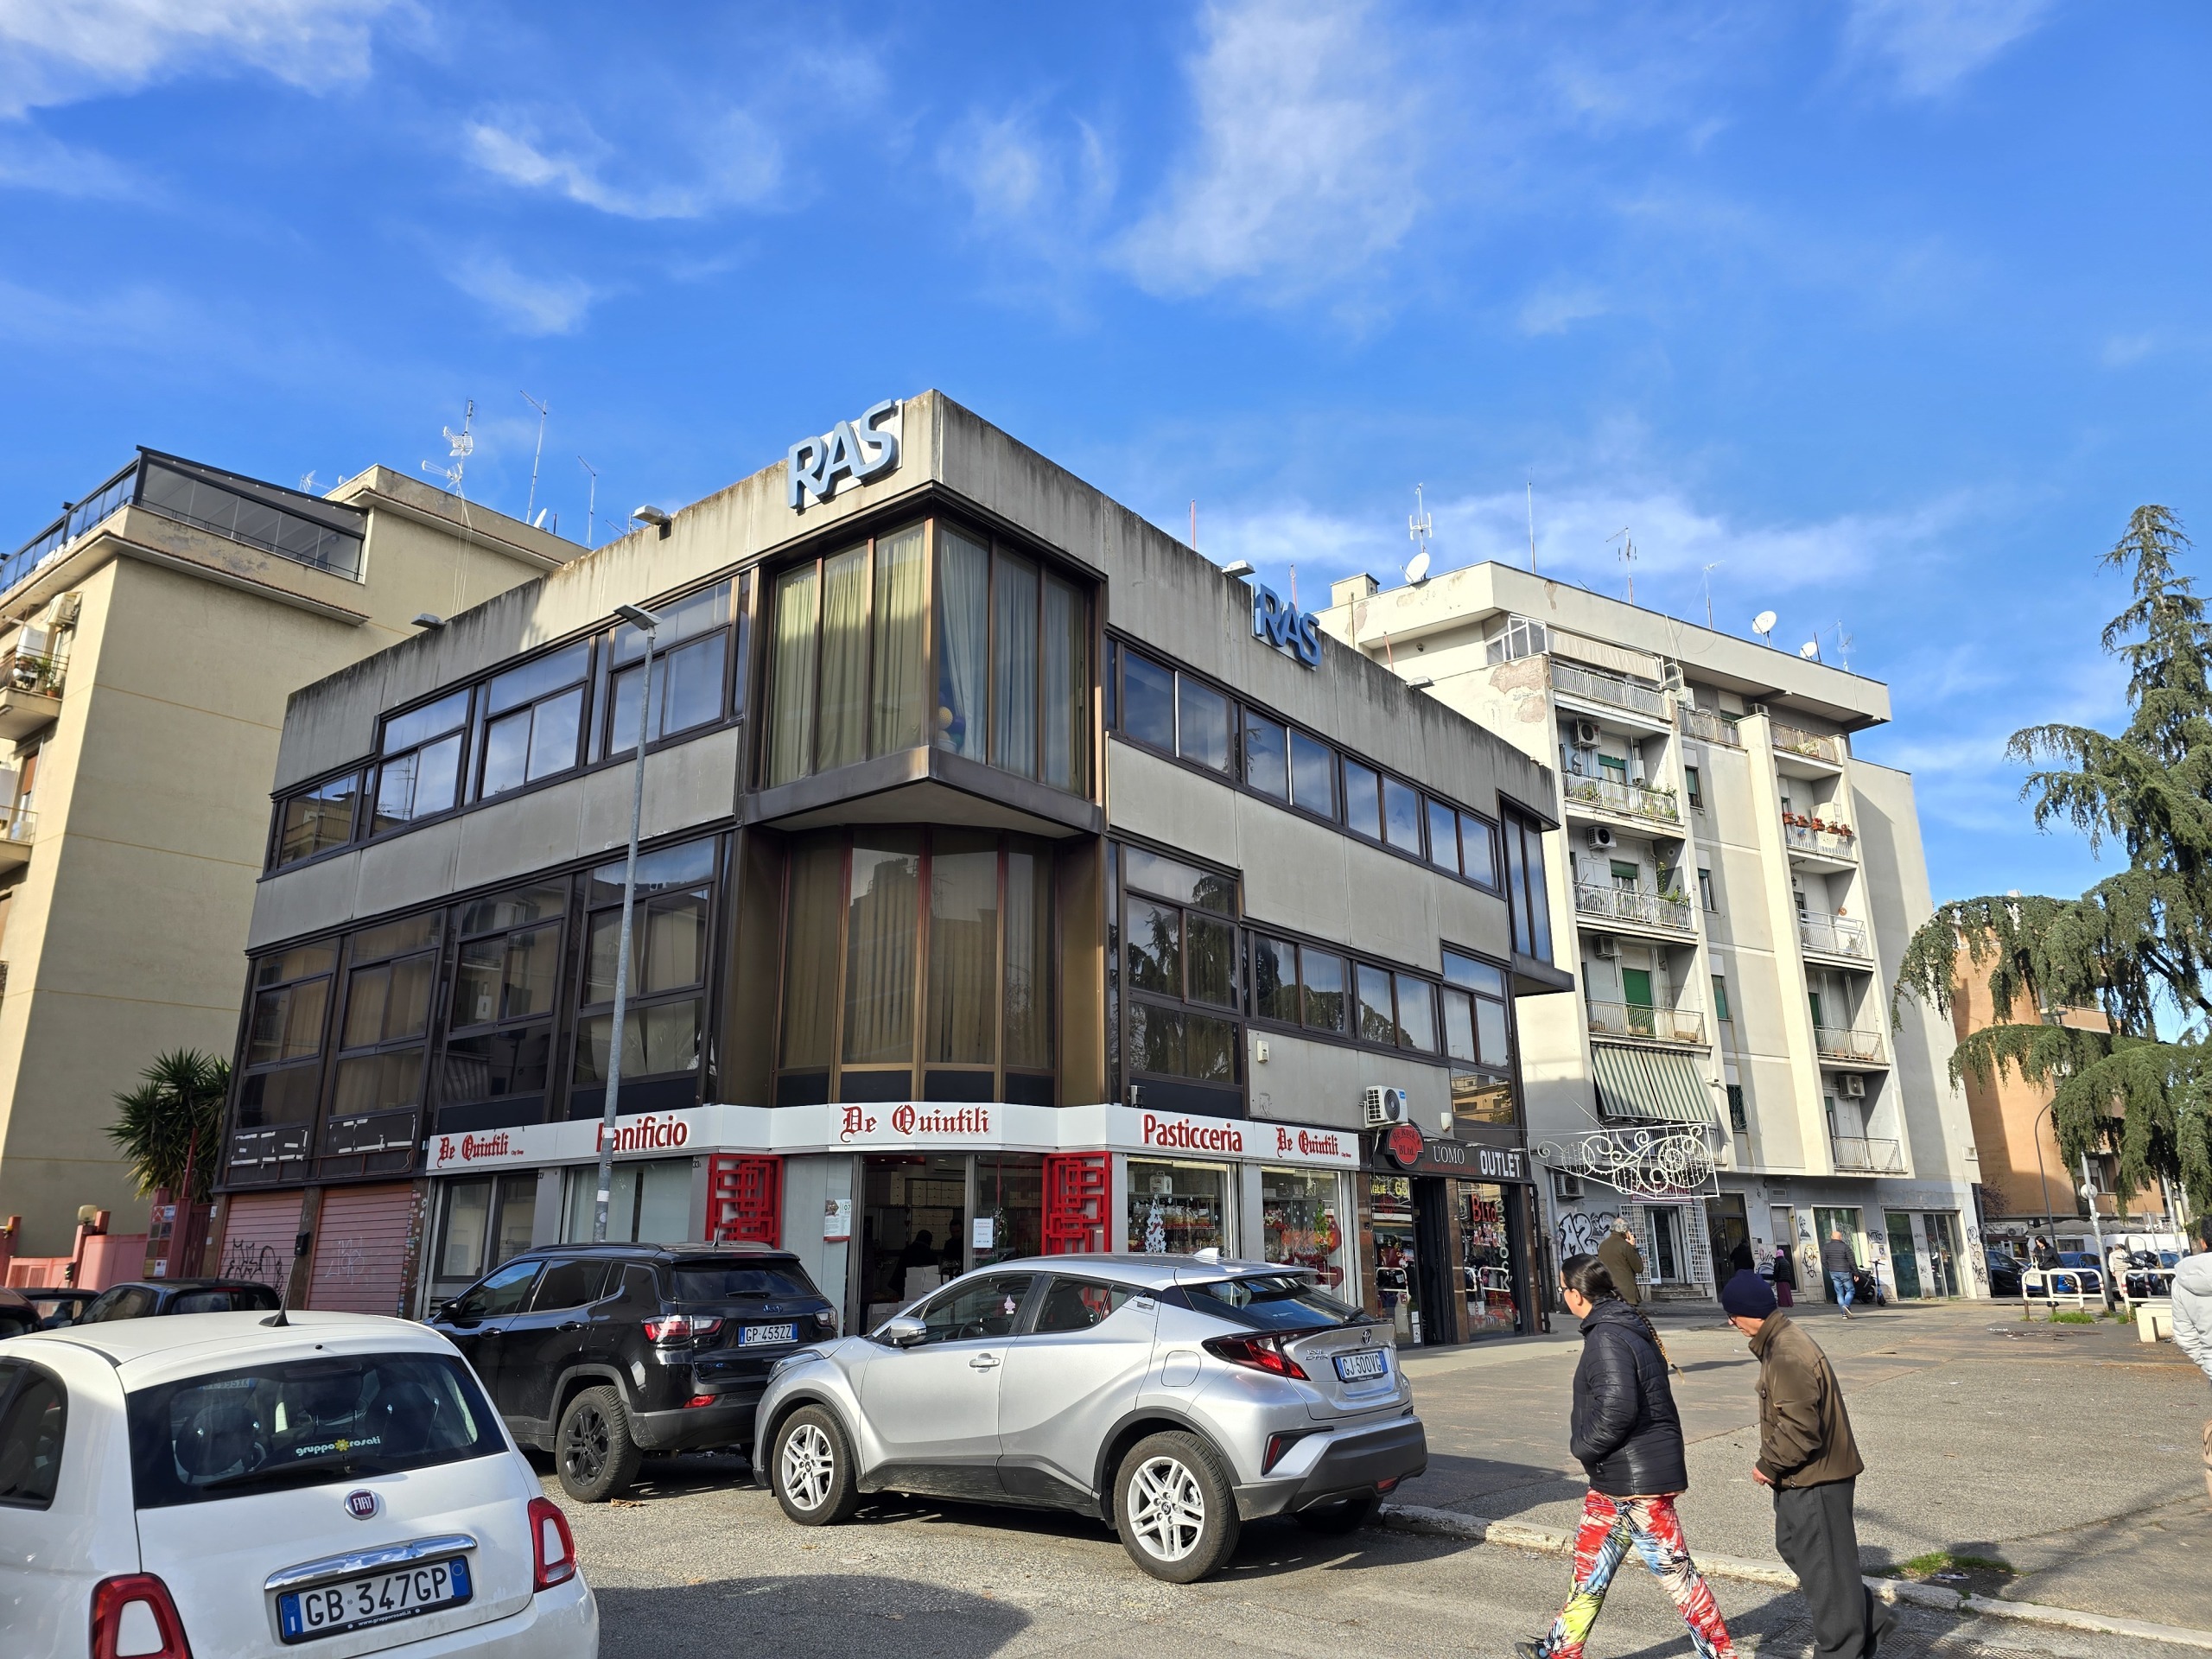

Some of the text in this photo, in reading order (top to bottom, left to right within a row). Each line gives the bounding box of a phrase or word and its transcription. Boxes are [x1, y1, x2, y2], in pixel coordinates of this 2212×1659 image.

[788, 398, 895, 509] RAS
[1255, 583, 1321, 666] RAS
[596, 1115, 688, 1153] Panificio
[840, 1104, 989, 1143] De Quintili
[1143, 1114, 1243, 1152] Pasticceria
[436, 1136, 455, 1168] De
[461, 1132, 509, 1161] Quintili
[1276, 1127, 1293, 1158] De
[1299, 1129, 1338, 1156] Quintili
[1433, 1146, 1465, 1165] UOMO
[1480, 1149, 1520, 1178] OUTLET
[746, 1325, 792, 1342] GP 453ZZ
[296, 1435, 381, 1457] gruppo rosati
[353, 1496, 372, 1511] FIAT
[305, 1589, 344, 1626] GB
[355, 1567, 448, 1616] 347GP
[358, 1610, 412, 1626] www.grupporosati.it
